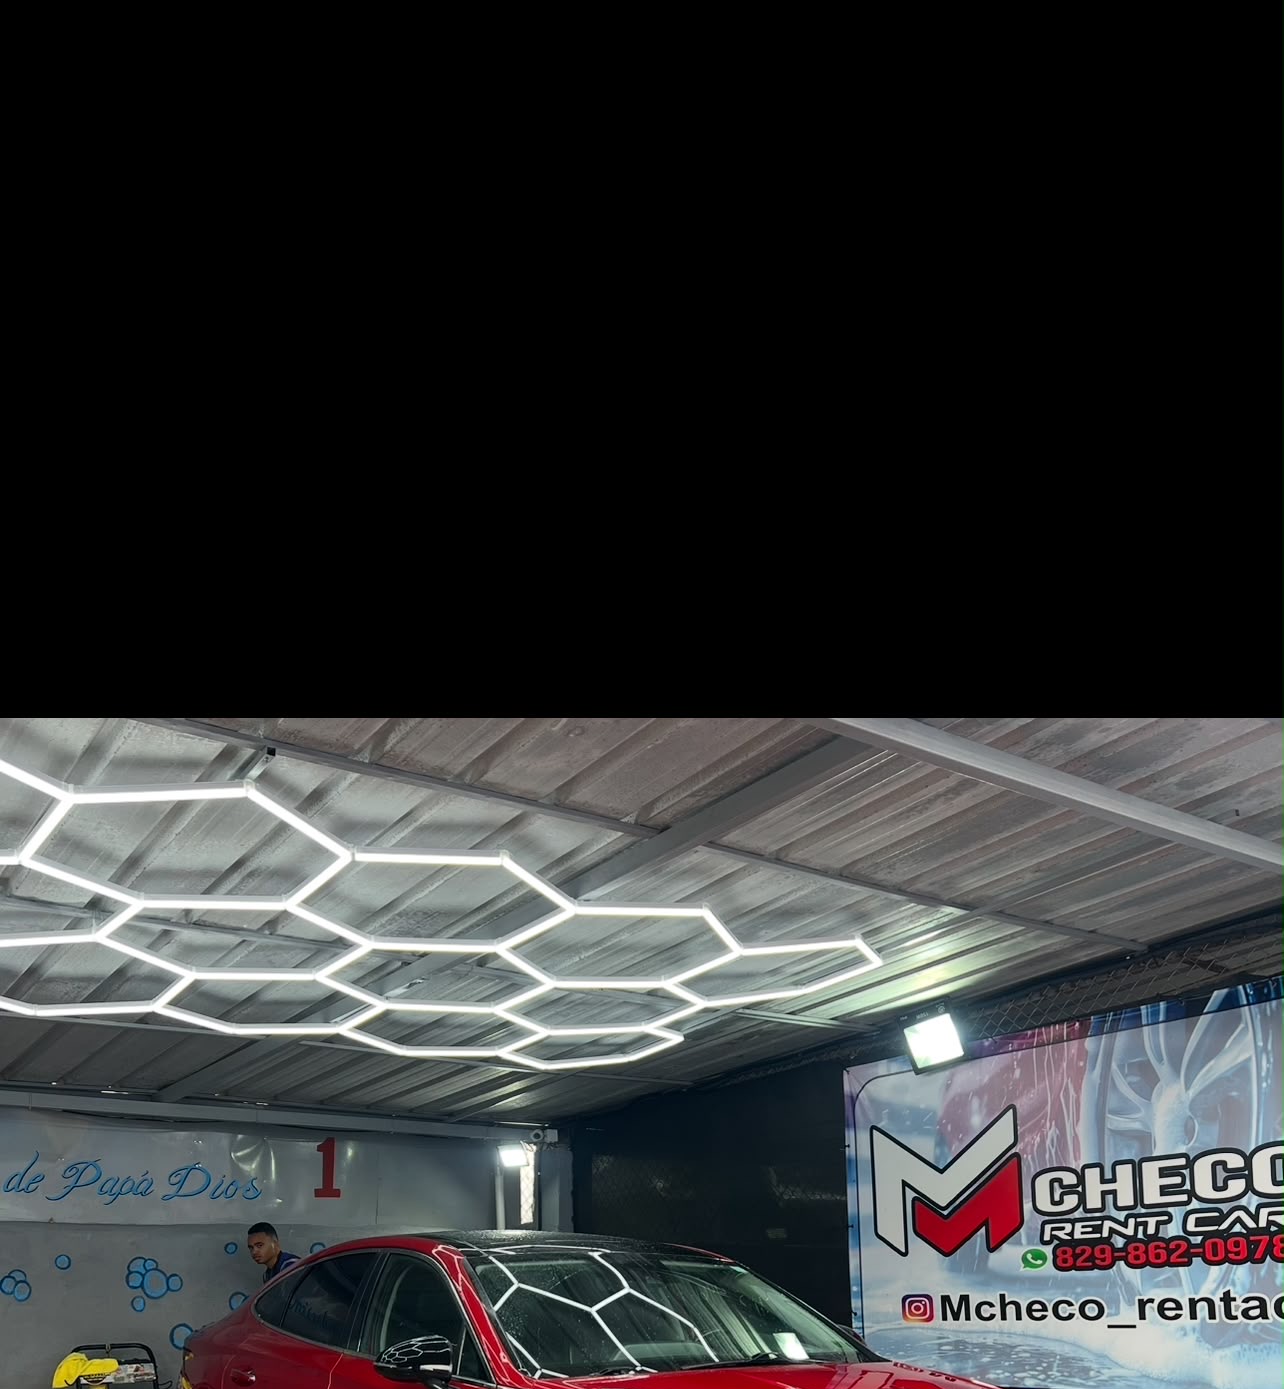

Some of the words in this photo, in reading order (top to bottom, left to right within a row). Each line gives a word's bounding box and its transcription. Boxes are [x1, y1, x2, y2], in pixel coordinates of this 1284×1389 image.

[3, 1151, 45, 1193] de
[45, 1159, 154, 1205] Papá
[161, 1162, 262, 1200] Dios
[314, 1136, 341, 1198] 1
[1032, 1143, 1284, 1215] CHECO
[1042, 1213, 1170, 1242] RENT
[1185, 1205, 1284, 1233] CAR
[1055, 1235, 1284, 1269] 829-862-0978
